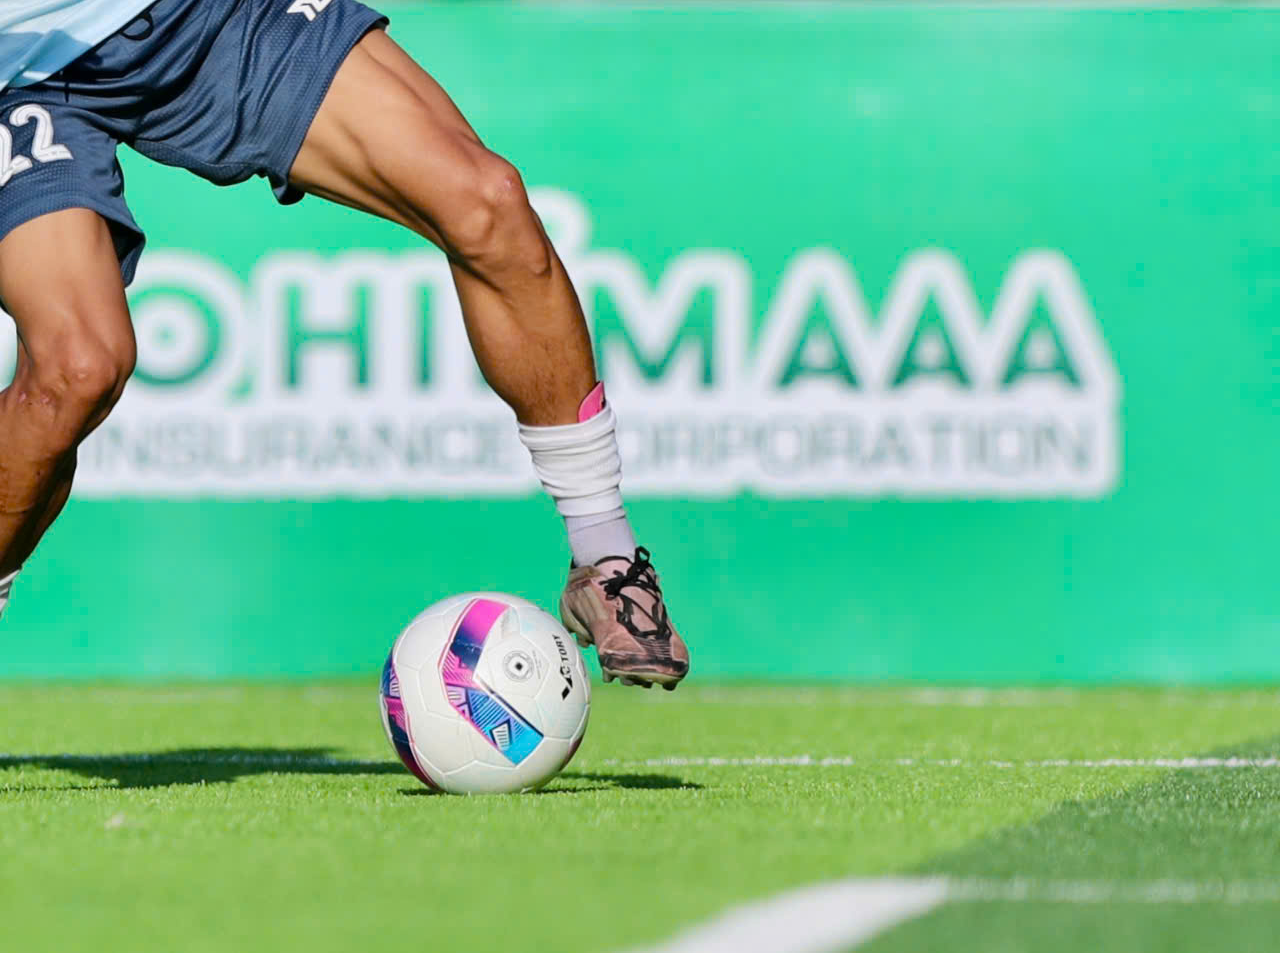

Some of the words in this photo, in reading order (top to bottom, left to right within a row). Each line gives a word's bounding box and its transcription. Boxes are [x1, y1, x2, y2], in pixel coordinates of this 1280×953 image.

[283, 277, 713, 393] HIM
[773, 277, 1086, 393] AAA
[617, 417, 1092, 477] ORPORATION
